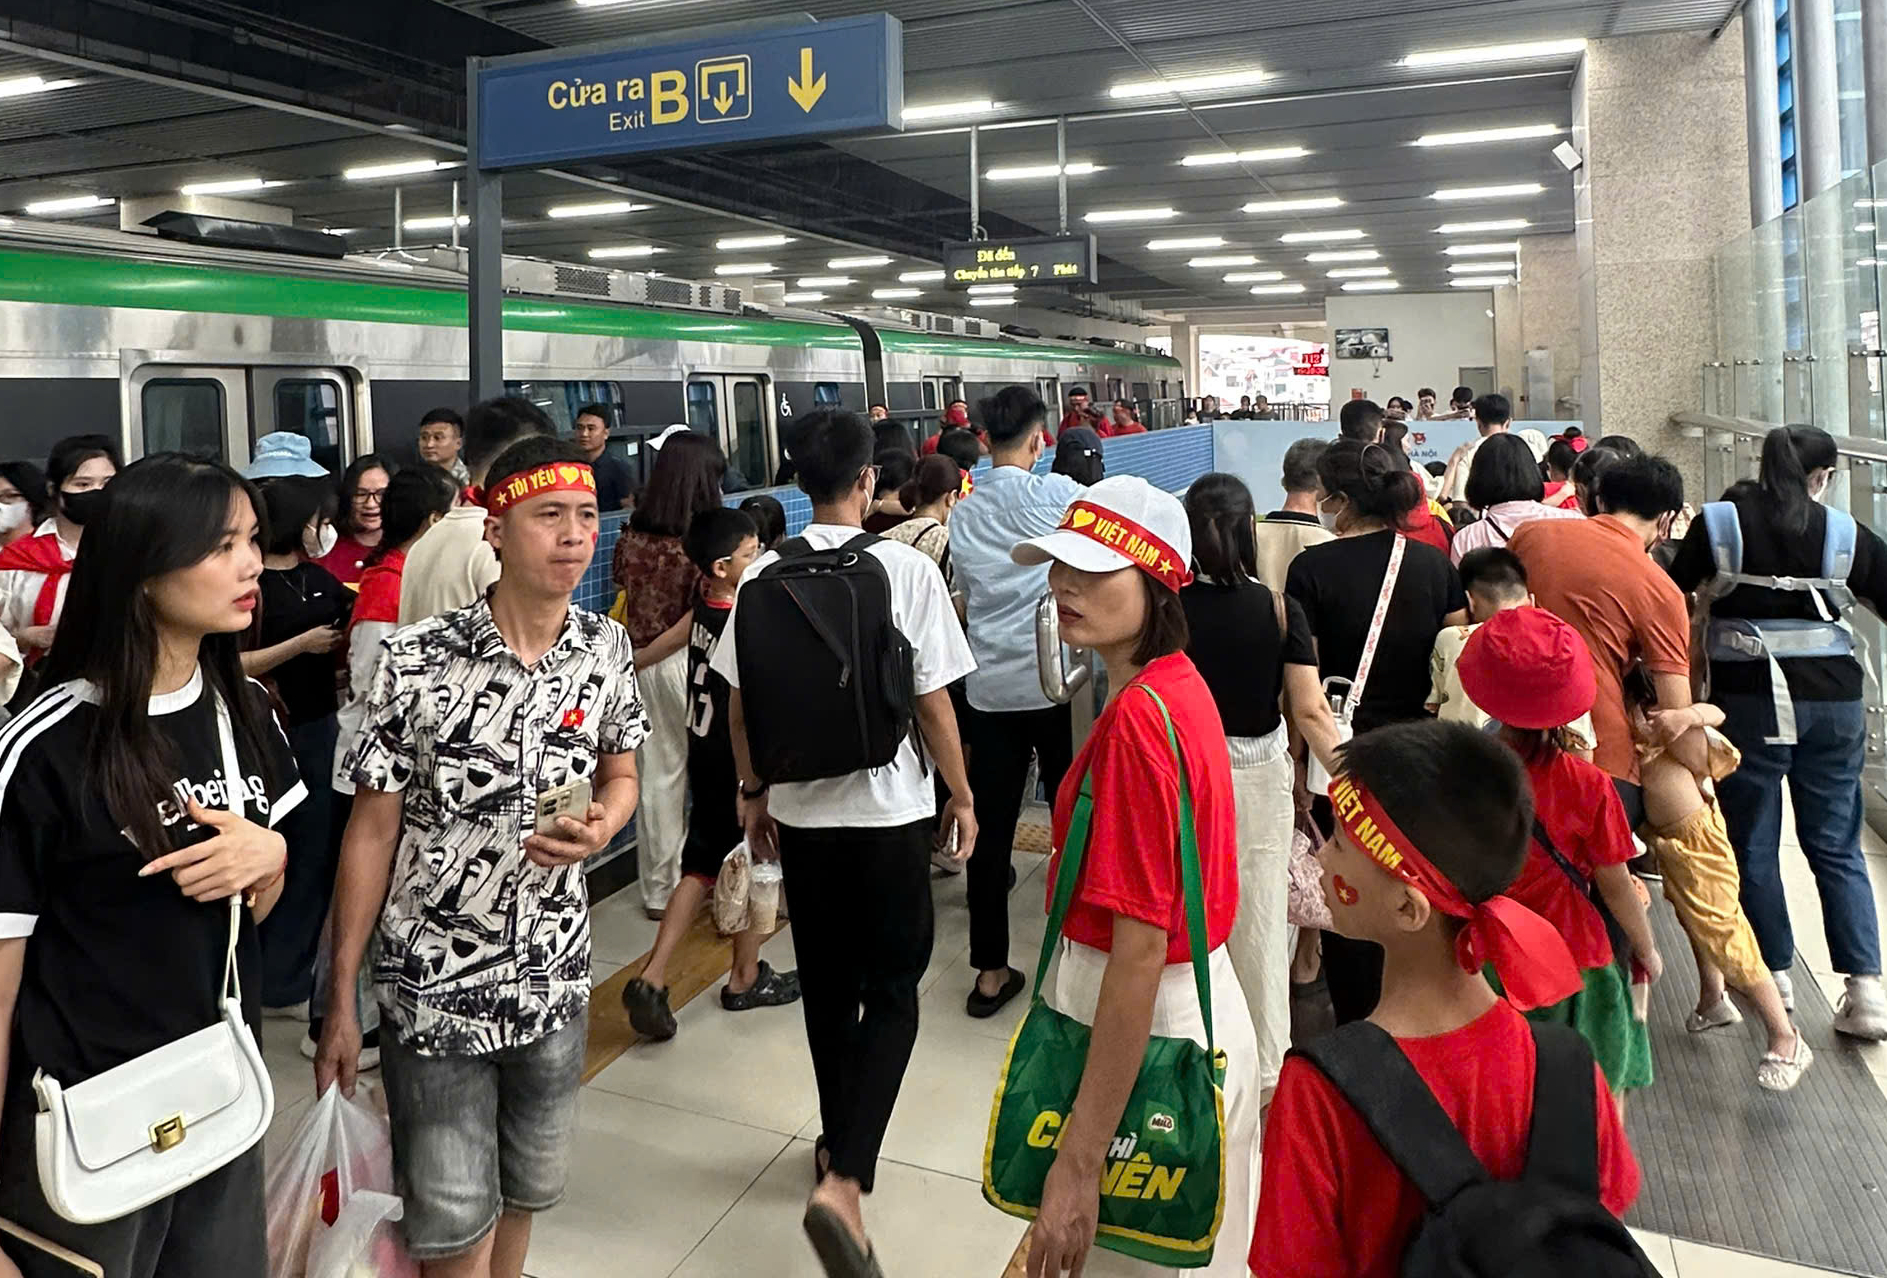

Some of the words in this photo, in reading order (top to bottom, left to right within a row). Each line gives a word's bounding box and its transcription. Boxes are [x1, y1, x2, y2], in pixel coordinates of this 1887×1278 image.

[547, 78, 607, 110] Cửa
[616, 77, 645, 102] ra
[650, 70, 690, 126] B
[609, 110, 646, 132] Exit
[1030, 265, 1039, 277] 7
[507, 477, 530, 500] TÔI
[529, 468, 557, 490] YÊU
[1093, 517, 1128, 546] VIỆT
[1124, 533, 1161, 568] NAM
[1354, 816, 1404, 870] NAM
[1109, 1131, 1139, 1160] HÌ
